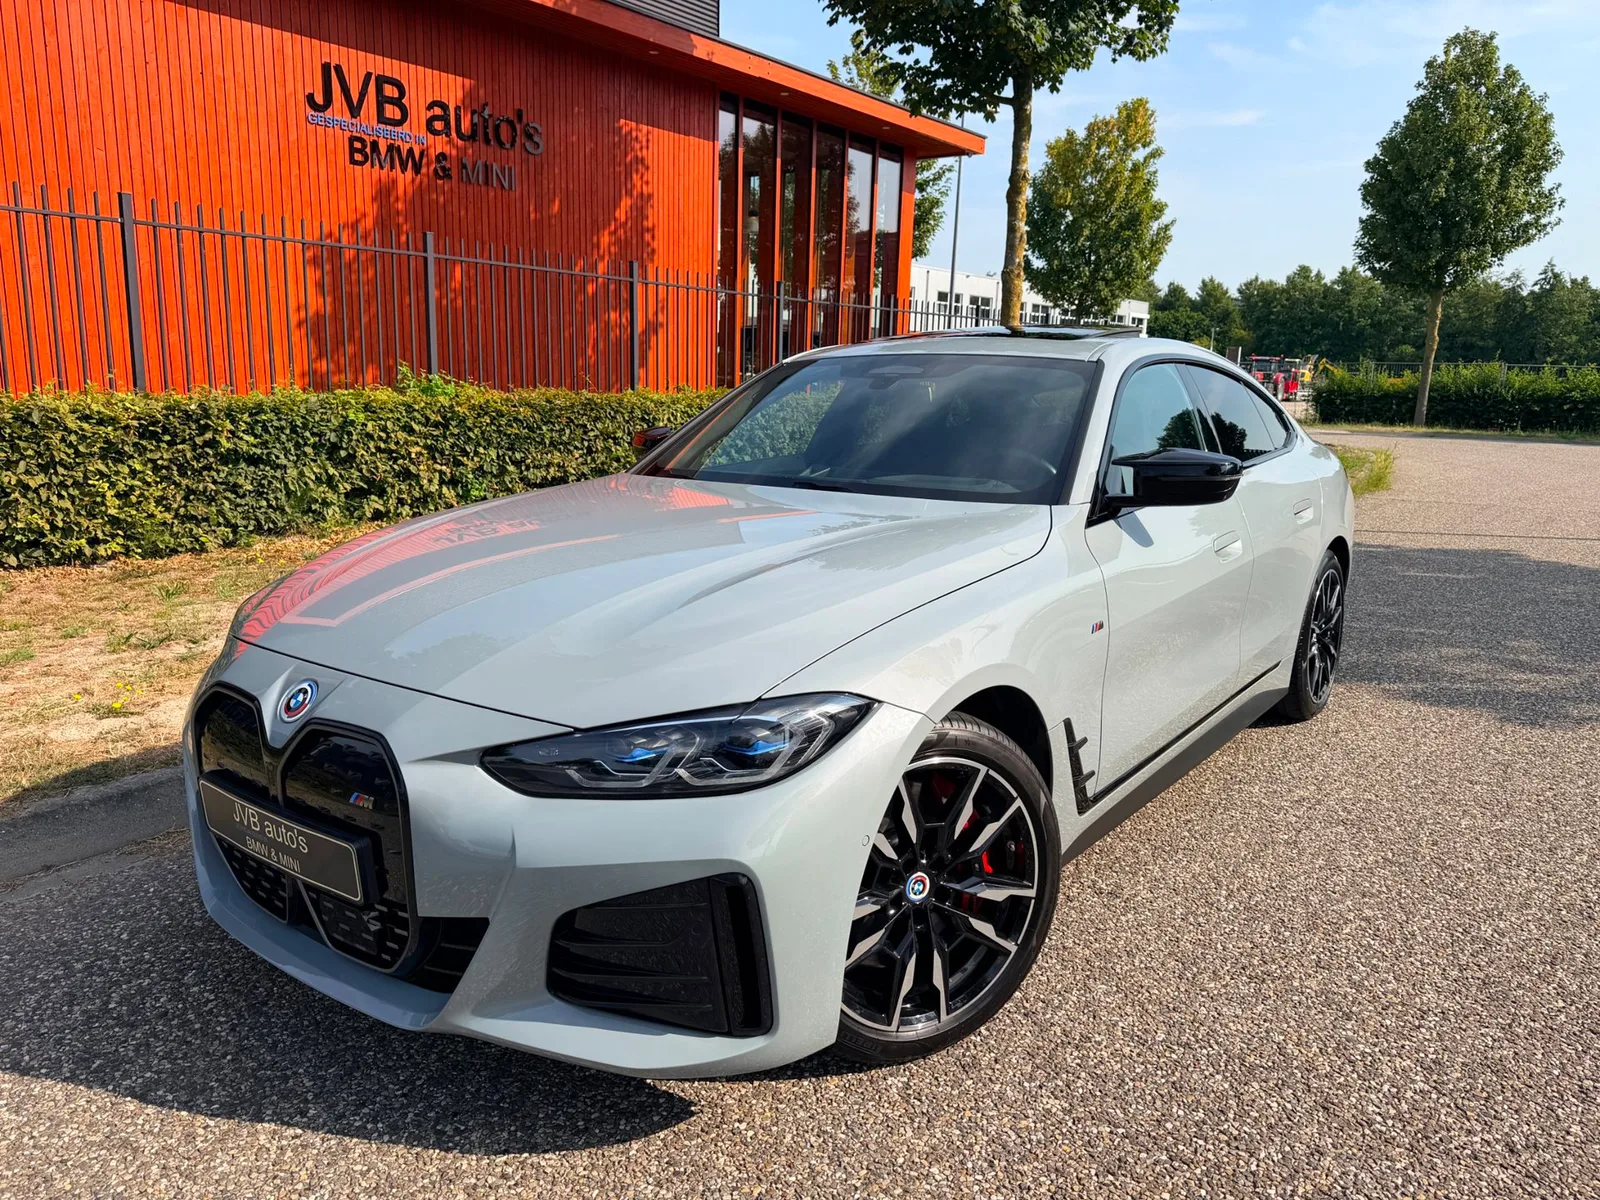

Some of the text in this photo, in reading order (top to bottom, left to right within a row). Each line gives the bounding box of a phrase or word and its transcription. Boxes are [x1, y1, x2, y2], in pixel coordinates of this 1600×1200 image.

[306, 61, 544, 155] JVB auto's
[308, 111, 427, 147] GESPECIALISEERD IN
[348, 134, 516, 191] BMW & MINI
[233, 802, 261, 831] JVB
[264, 820, 308, 853] auto's
[246, 836, 301, 873] BMW & MINI
